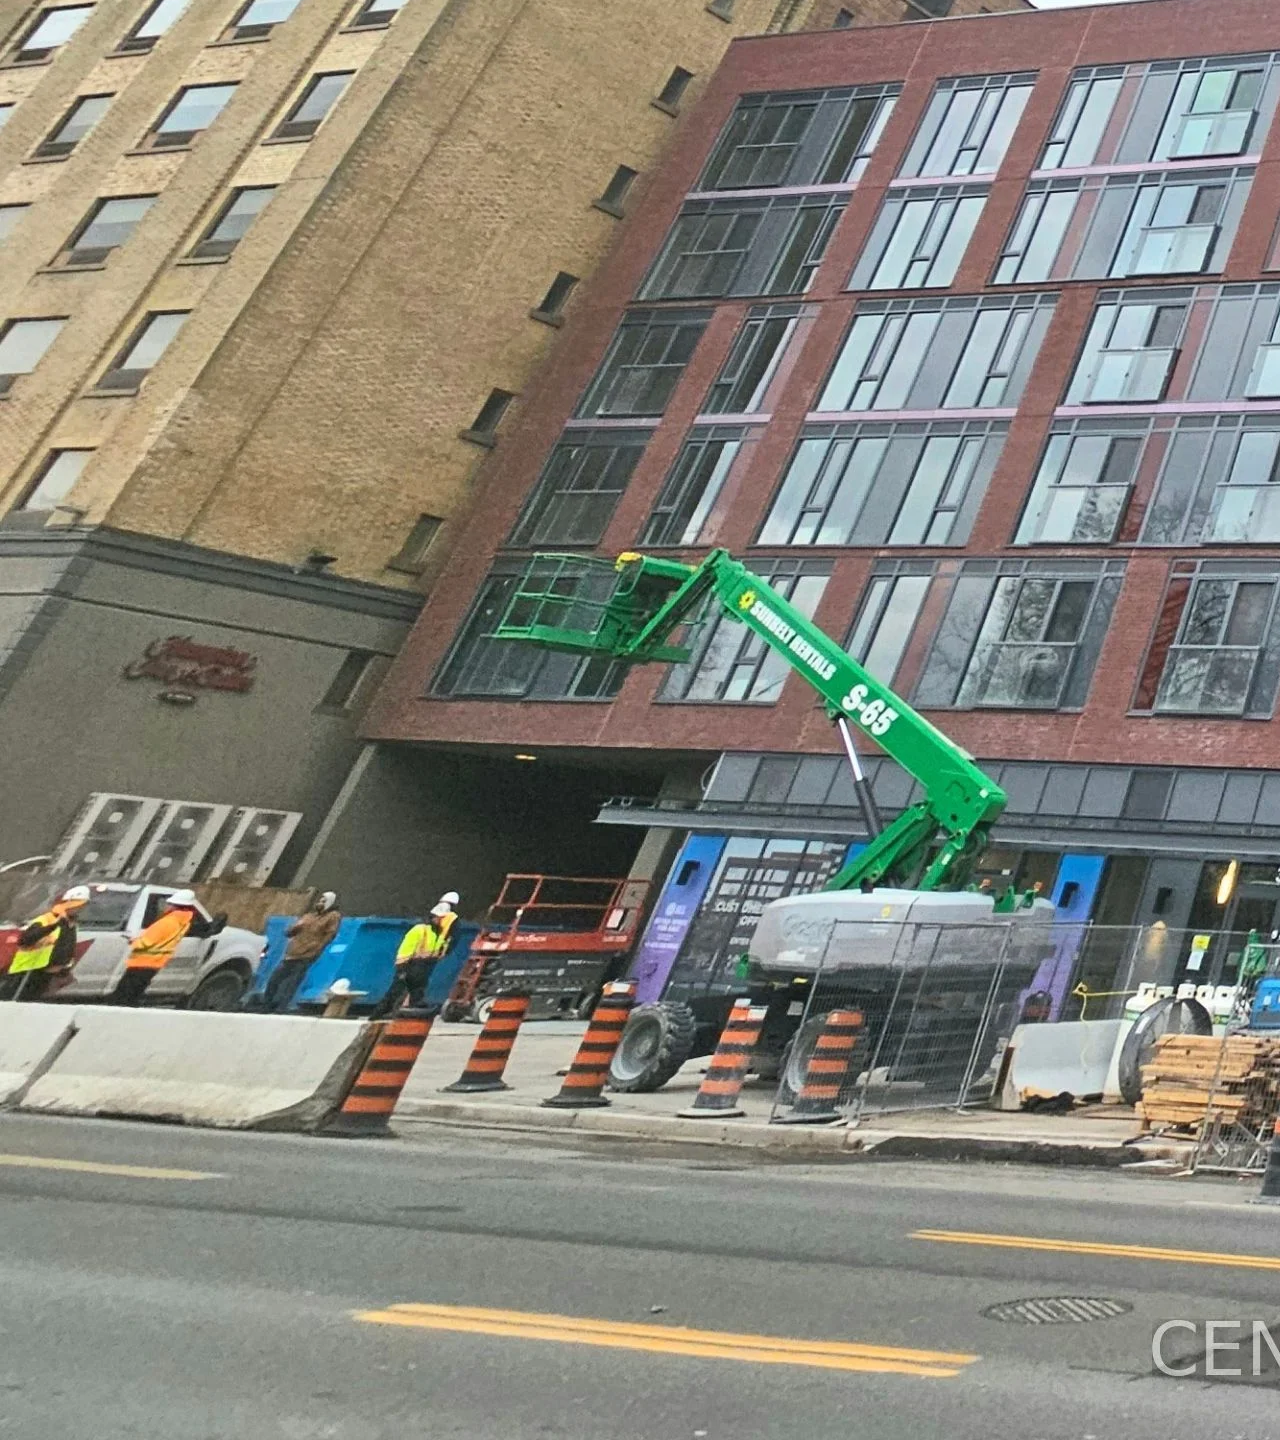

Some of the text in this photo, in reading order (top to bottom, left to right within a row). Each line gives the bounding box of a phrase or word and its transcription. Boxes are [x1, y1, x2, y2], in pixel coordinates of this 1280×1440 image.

[750, 600, 837, 681] SUNBELT RENTALS
[842, 684, 899, 736] S-65
